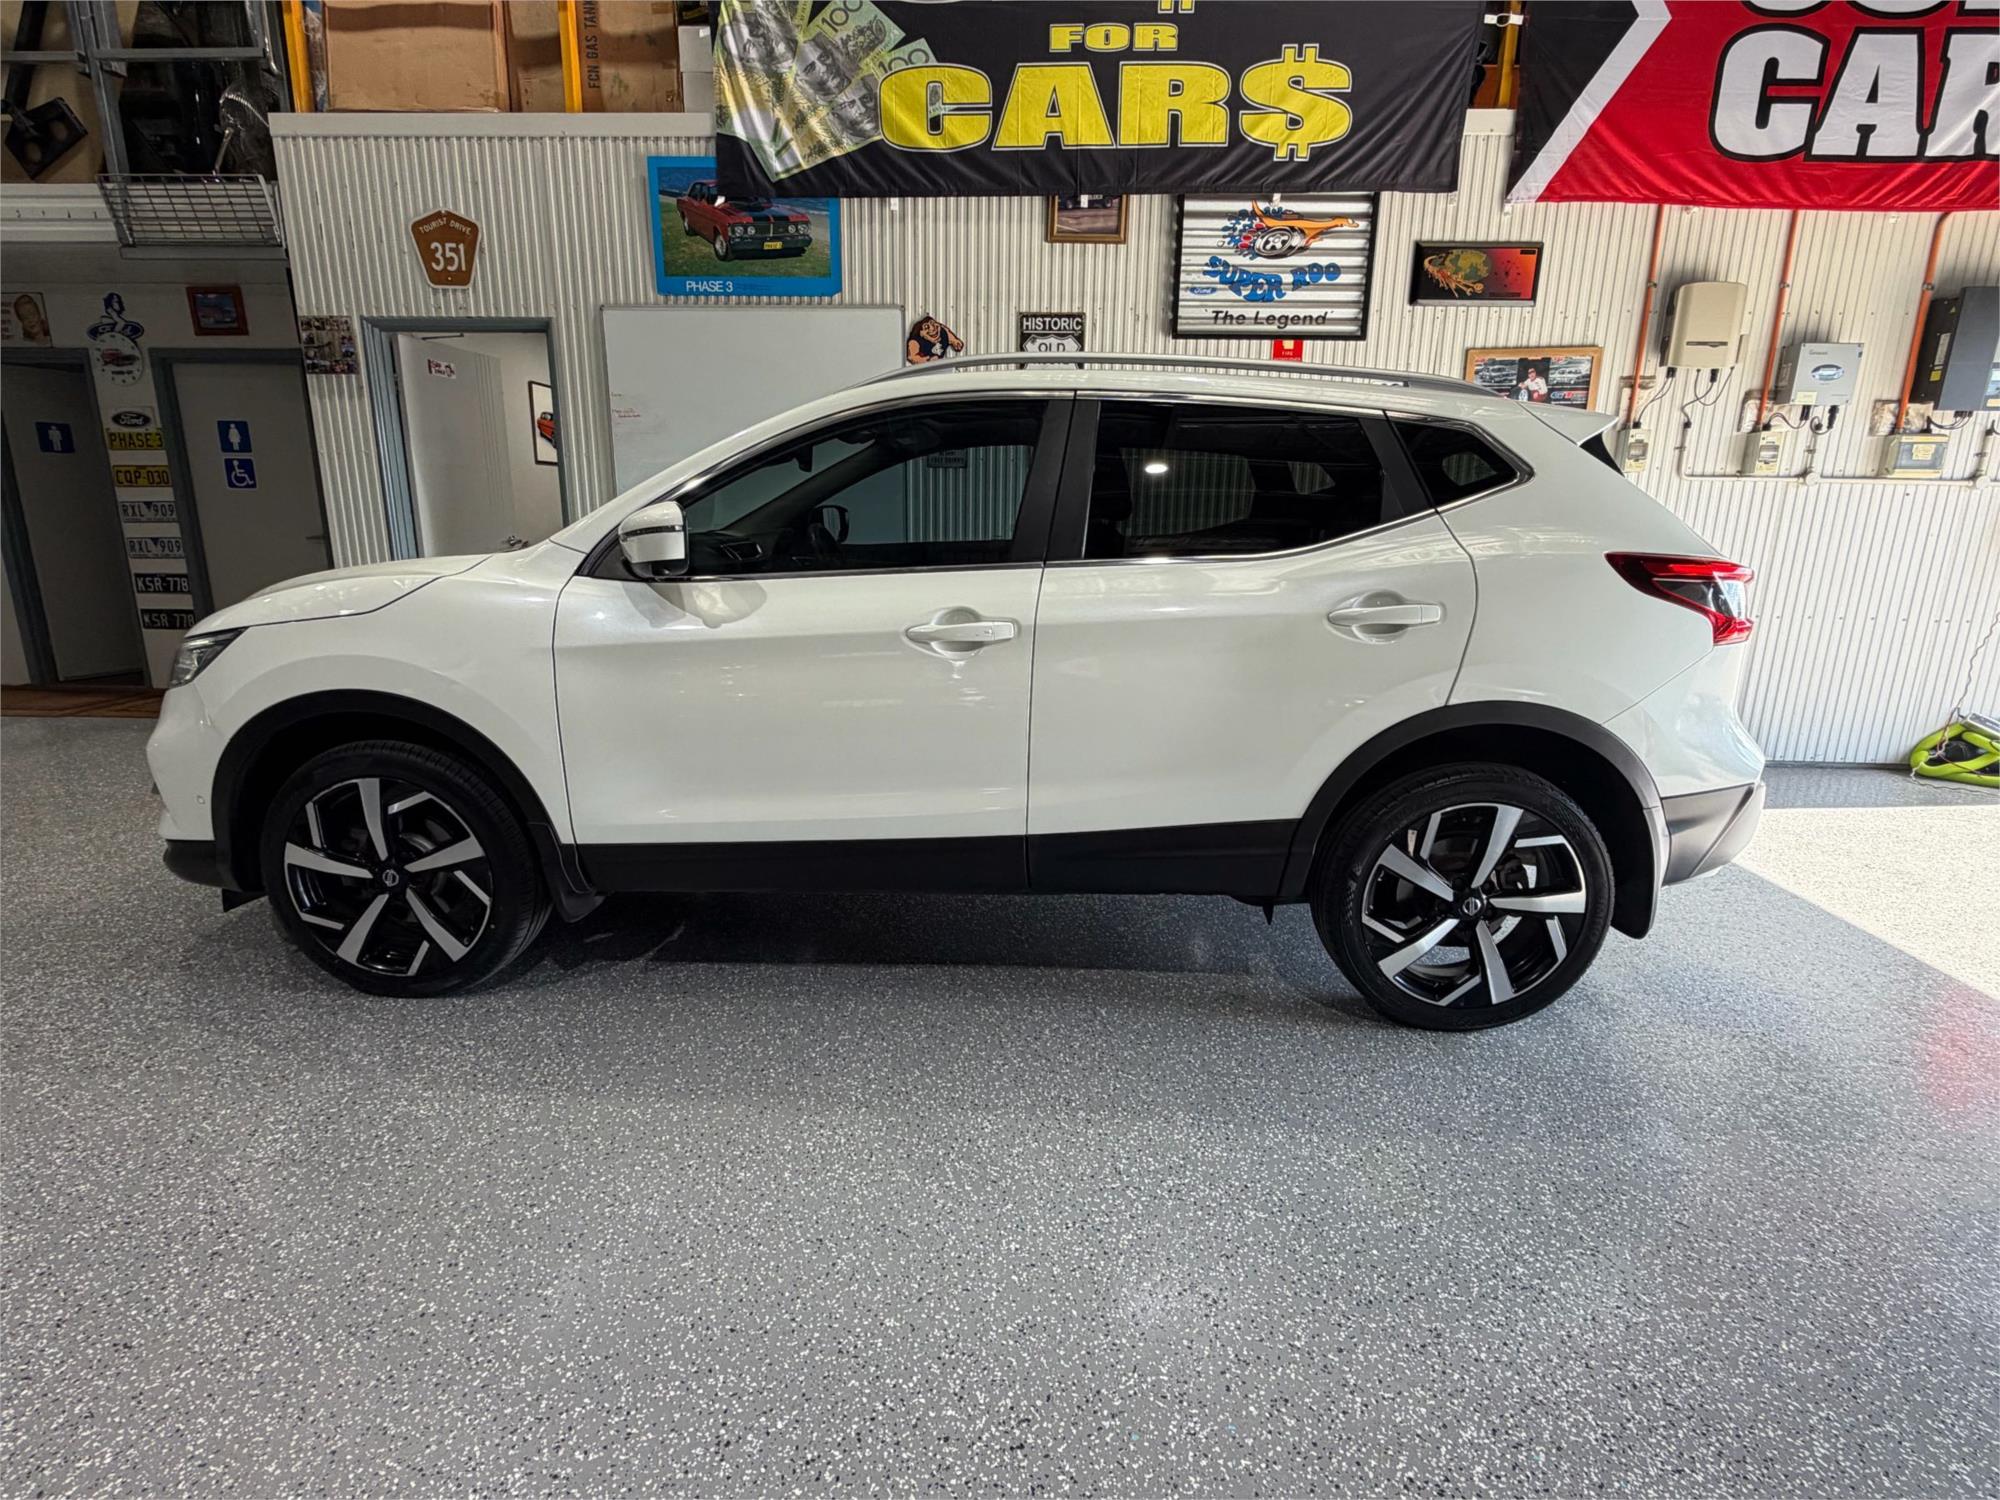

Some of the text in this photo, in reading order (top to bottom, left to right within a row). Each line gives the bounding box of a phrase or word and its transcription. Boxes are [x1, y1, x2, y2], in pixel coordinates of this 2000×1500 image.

[1049, 23, 1179, 52] FOR
[585, 35, 599, 59] GAS
[419, 217, 472, 236] TOURIST DRIVE
[430, 242, 466, 271] 351
[686, 281, 724, 292] PHASE
[726, 281, 734, 292] 3
[1202, 256, 1342, 303] SUPER ROO
[1023, 318, 1082, 331] HISTORIC
[120, 412, 146, 425] Ford
[108, 432, 163, 448] PHASE 3
[122, 504, 175, 517] RXL 909
[128, 540, 181, 552] RXL 909
